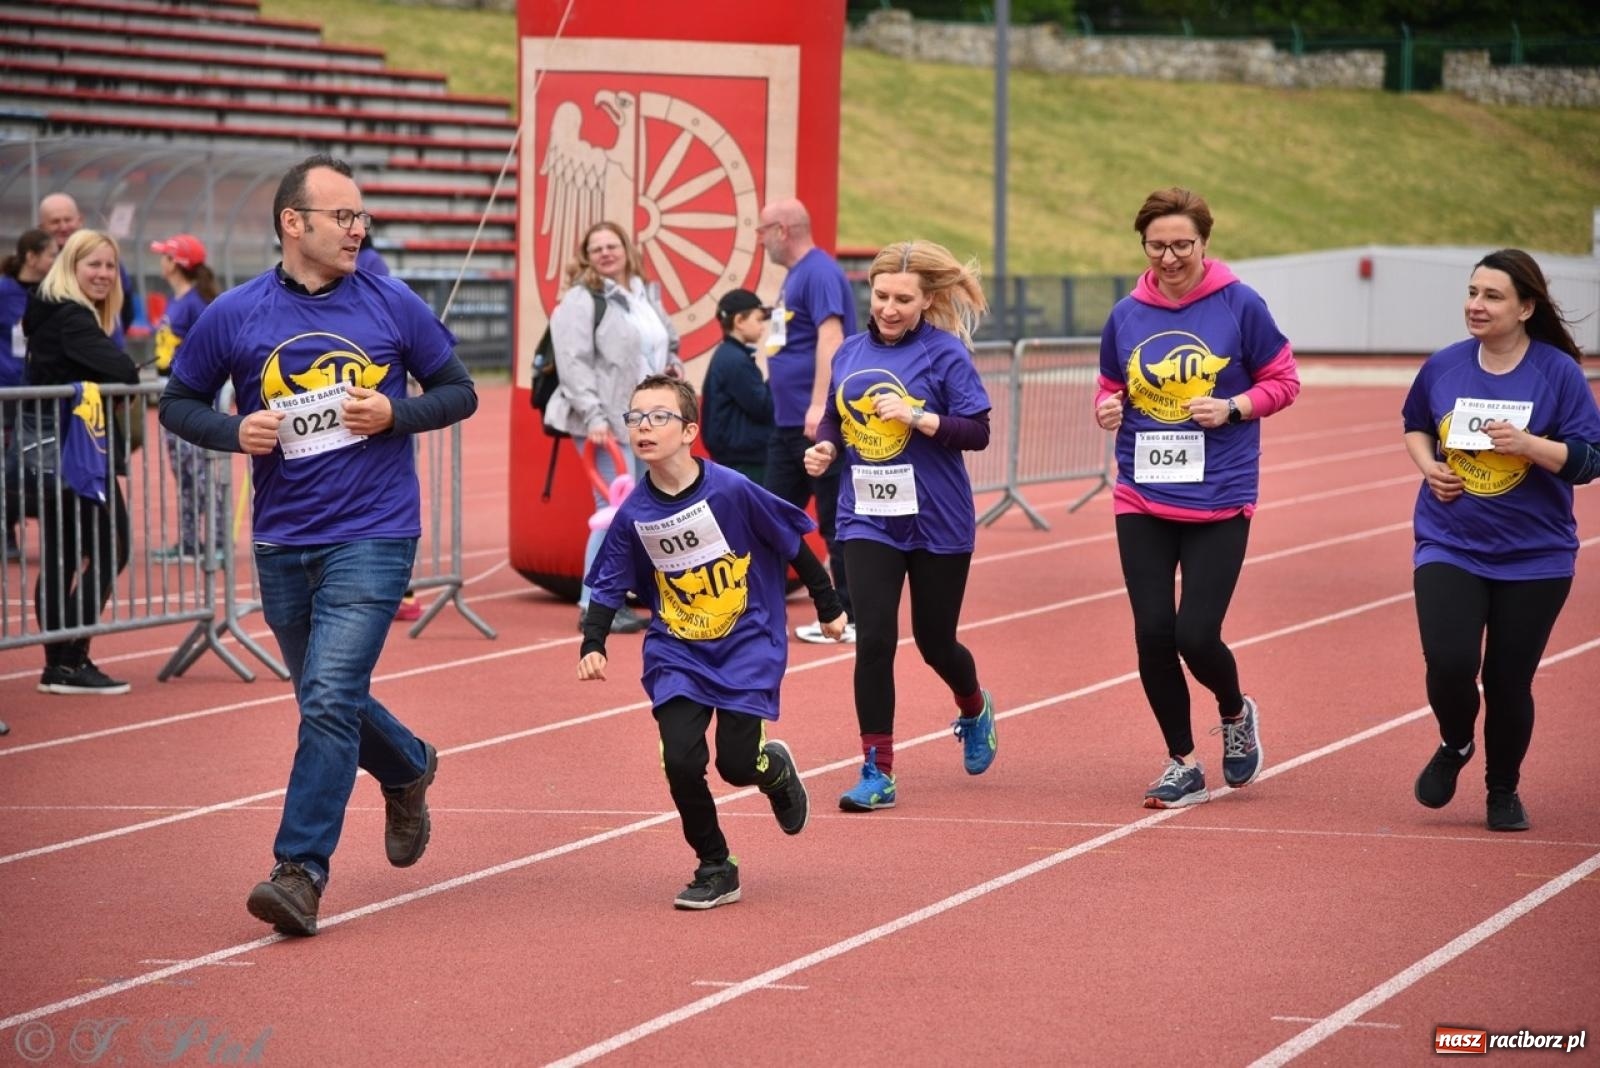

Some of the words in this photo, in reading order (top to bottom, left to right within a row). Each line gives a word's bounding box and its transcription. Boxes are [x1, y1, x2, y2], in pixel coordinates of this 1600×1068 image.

[1171, 353, 1203, 383] 10
[283, 399, 299, 409] BIEG
[299, 395, 315, 405] BEZ
[1132, 378, 1178, 409] RACIBORSKI
[293, 408, 340, 436] 022
[1149, 449, 1188, 466] 054
[868, 483, 898, 500] 129
[660, 519, 675, 530] BEZ
[659, 530, 700, 555] 018
[694, 561, 735, 599] 10
[664, 589, 710, 629] RACIBORSKI
